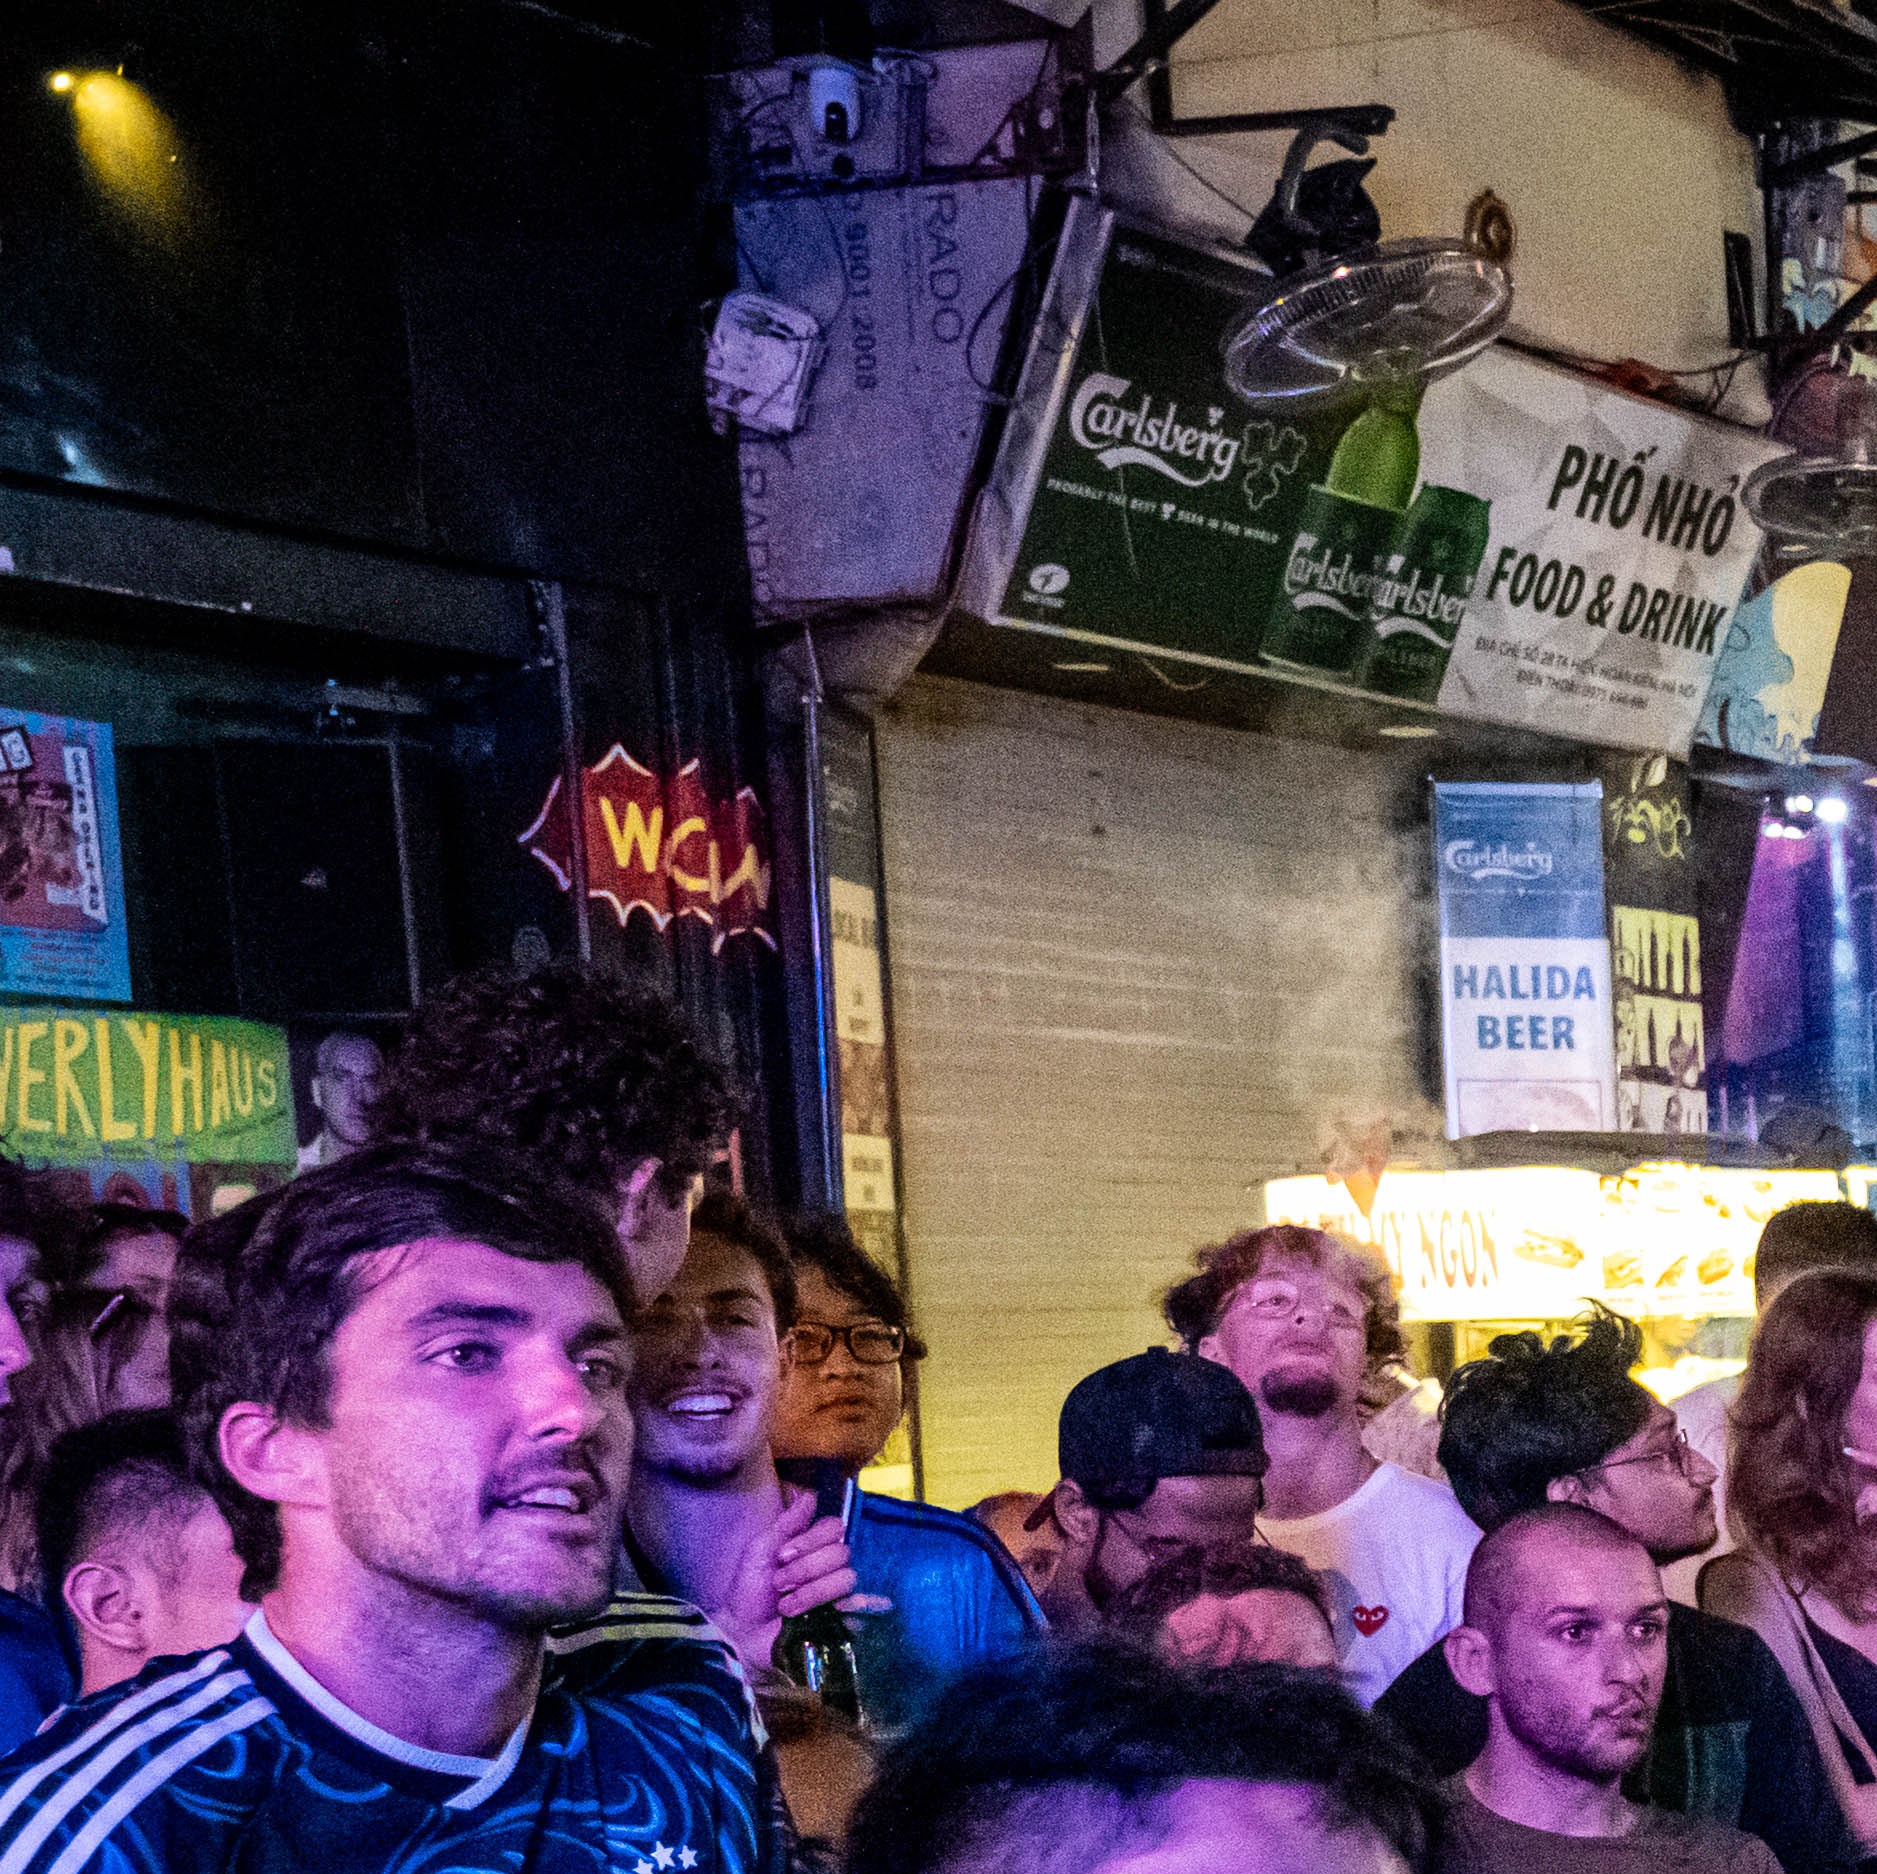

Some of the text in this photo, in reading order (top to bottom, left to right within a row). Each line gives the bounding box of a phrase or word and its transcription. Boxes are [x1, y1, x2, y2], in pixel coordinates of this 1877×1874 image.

[1069, 372, 1240, 486] Carlsberg
[1546, 444, 1739, 556] PHỐ NHỎ
[1486, 546, 1727, 656] FOOD & DRINK
[1446, 839, 1553, 881] Carlsberg
[1454, 964, 1596, 1000] HALIDA
[1477, 1014, 1575, 1050] BEER
